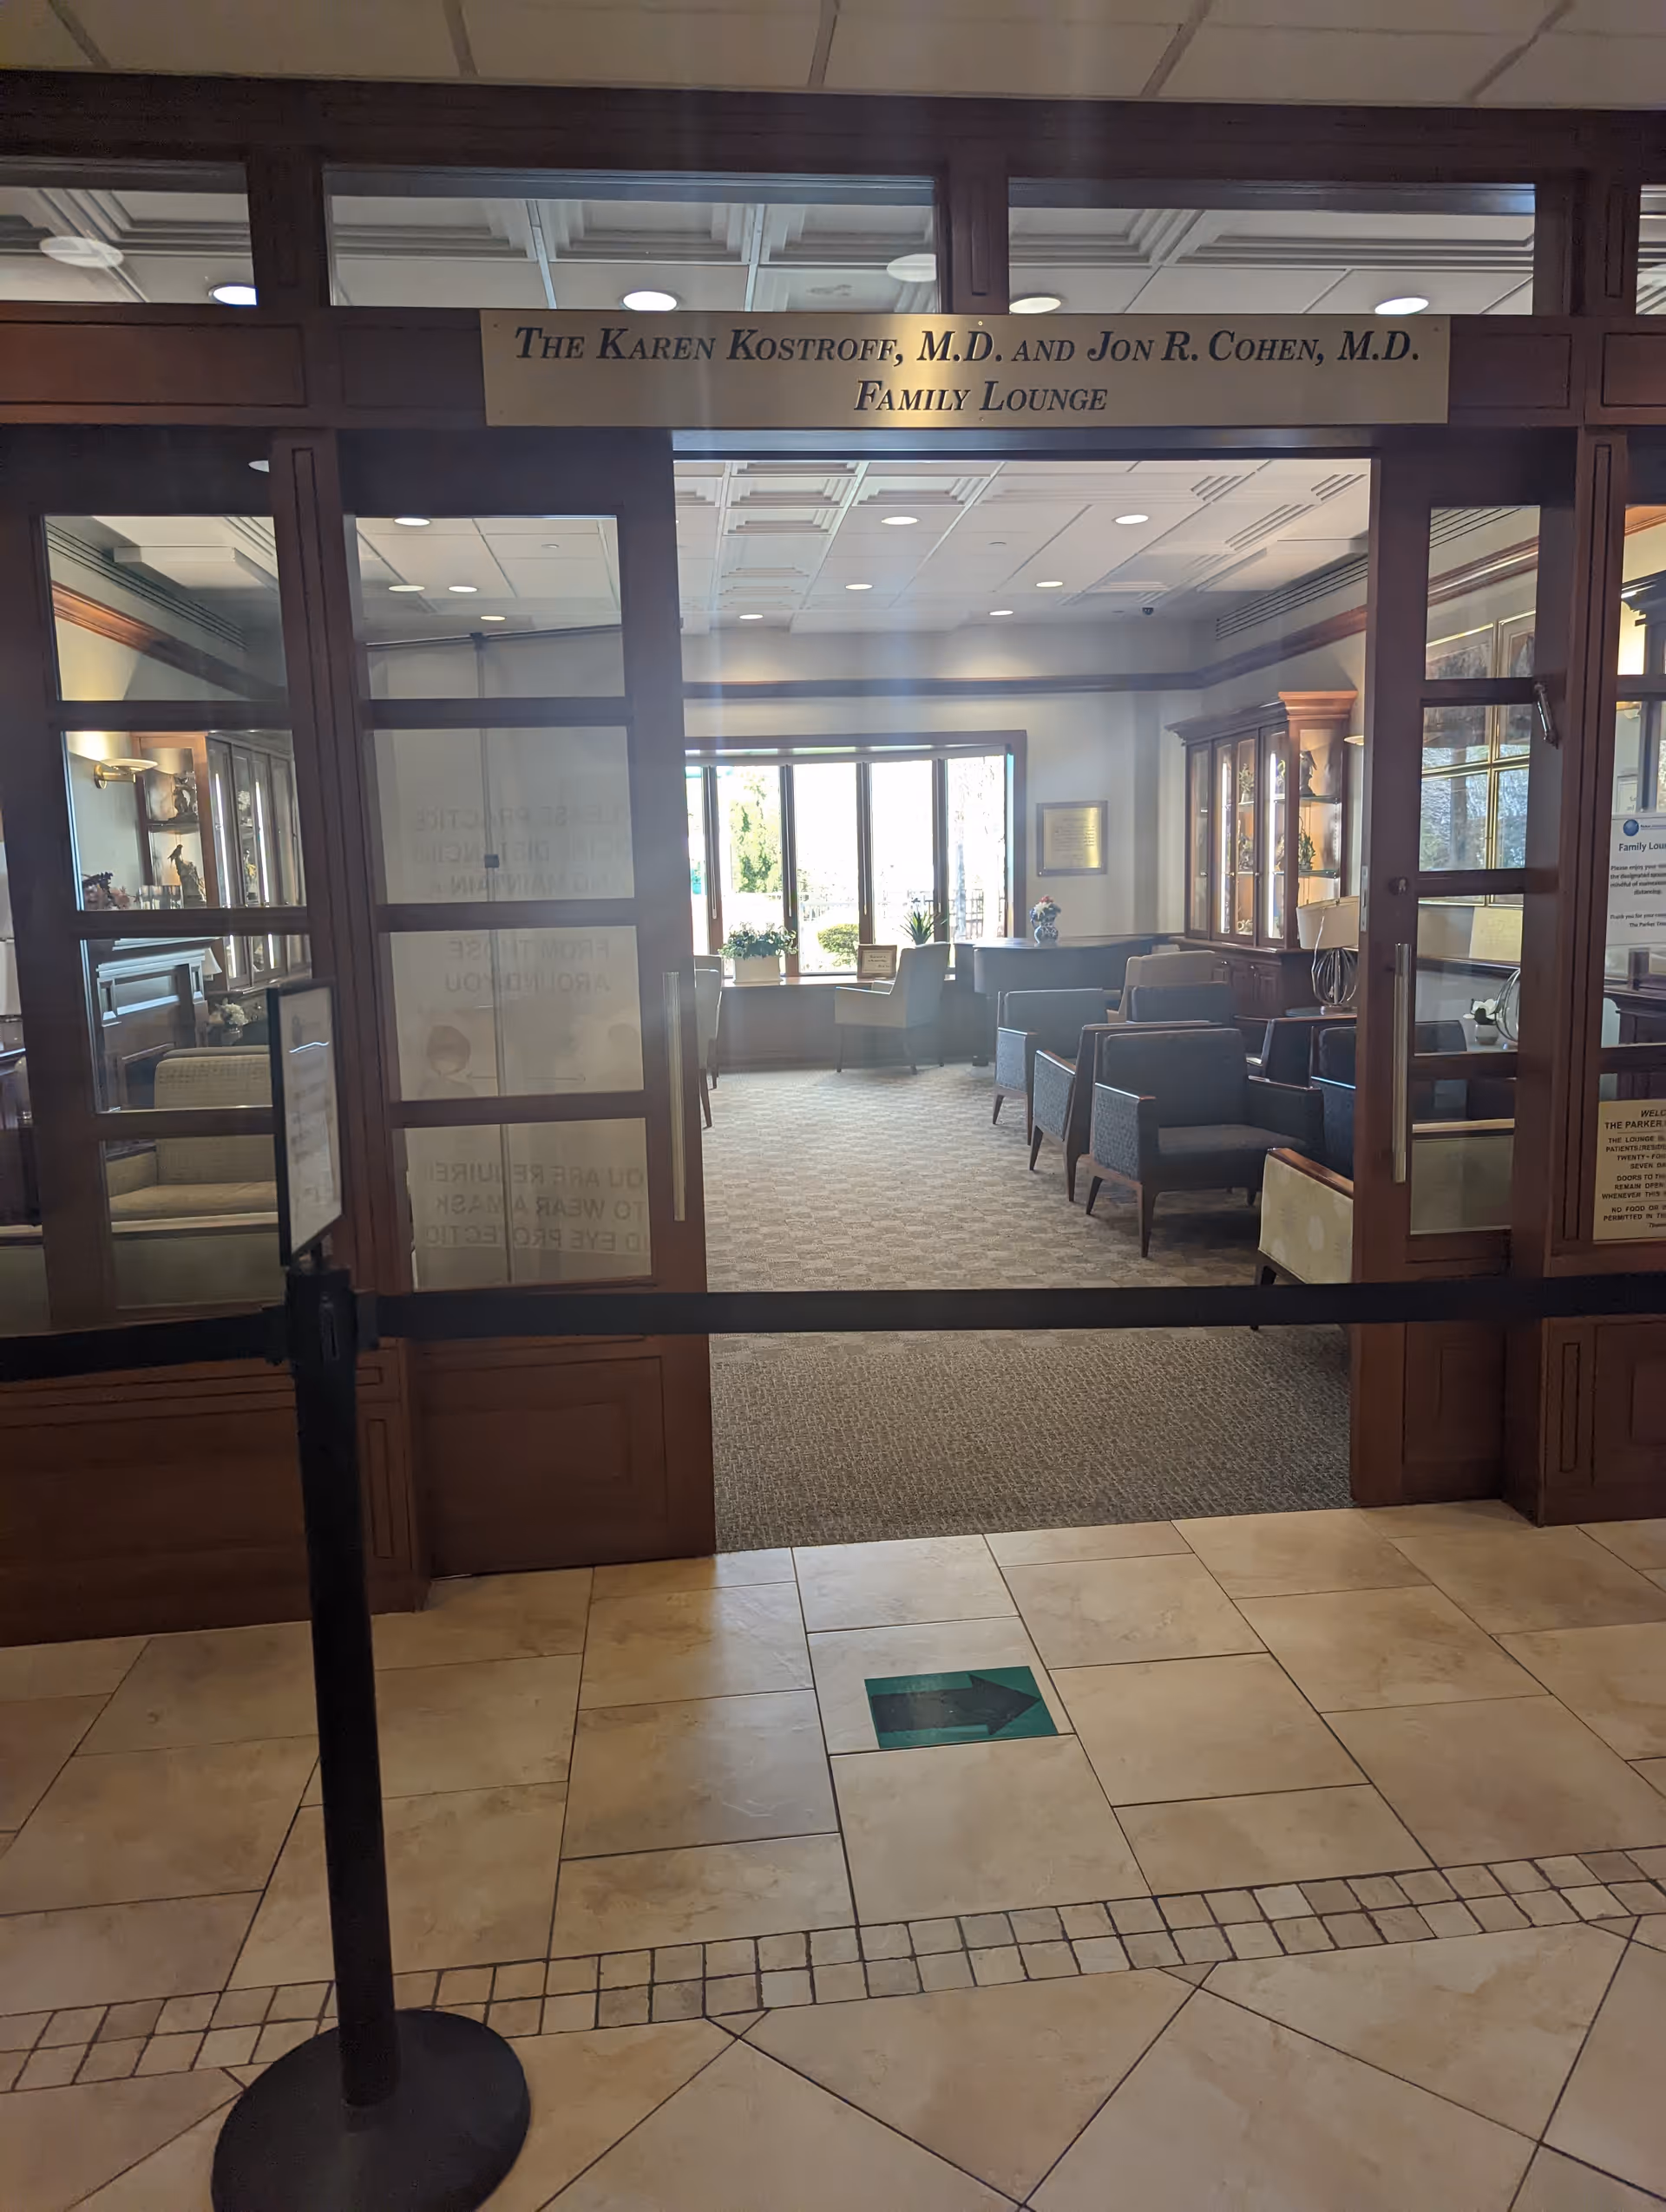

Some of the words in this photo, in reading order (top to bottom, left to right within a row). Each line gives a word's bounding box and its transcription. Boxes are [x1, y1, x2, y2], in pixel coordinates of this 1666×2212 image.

[515, 326, 585, 359] THE
[595, 328, 716, 361] KAREN
[725, 329, 904, 367] KOSTROFF,
[916, 330, 1002, 362] M.D.
[1011, 339, 1075, 362] AND
[1087, 330, 1154, 362] JON
[1161, 330, 1198, 361] R.
[1209, 330, 1324, 366] COHEN,
[1336, 330, 1419, 361] M.D.
[854, 380, 971, 411] FAMILY
[980, 380, 1108, 411] LOUNGE
[1618, 841, 1647, 853] Family
[1625, 1120, 1662, 1129] PARKER
